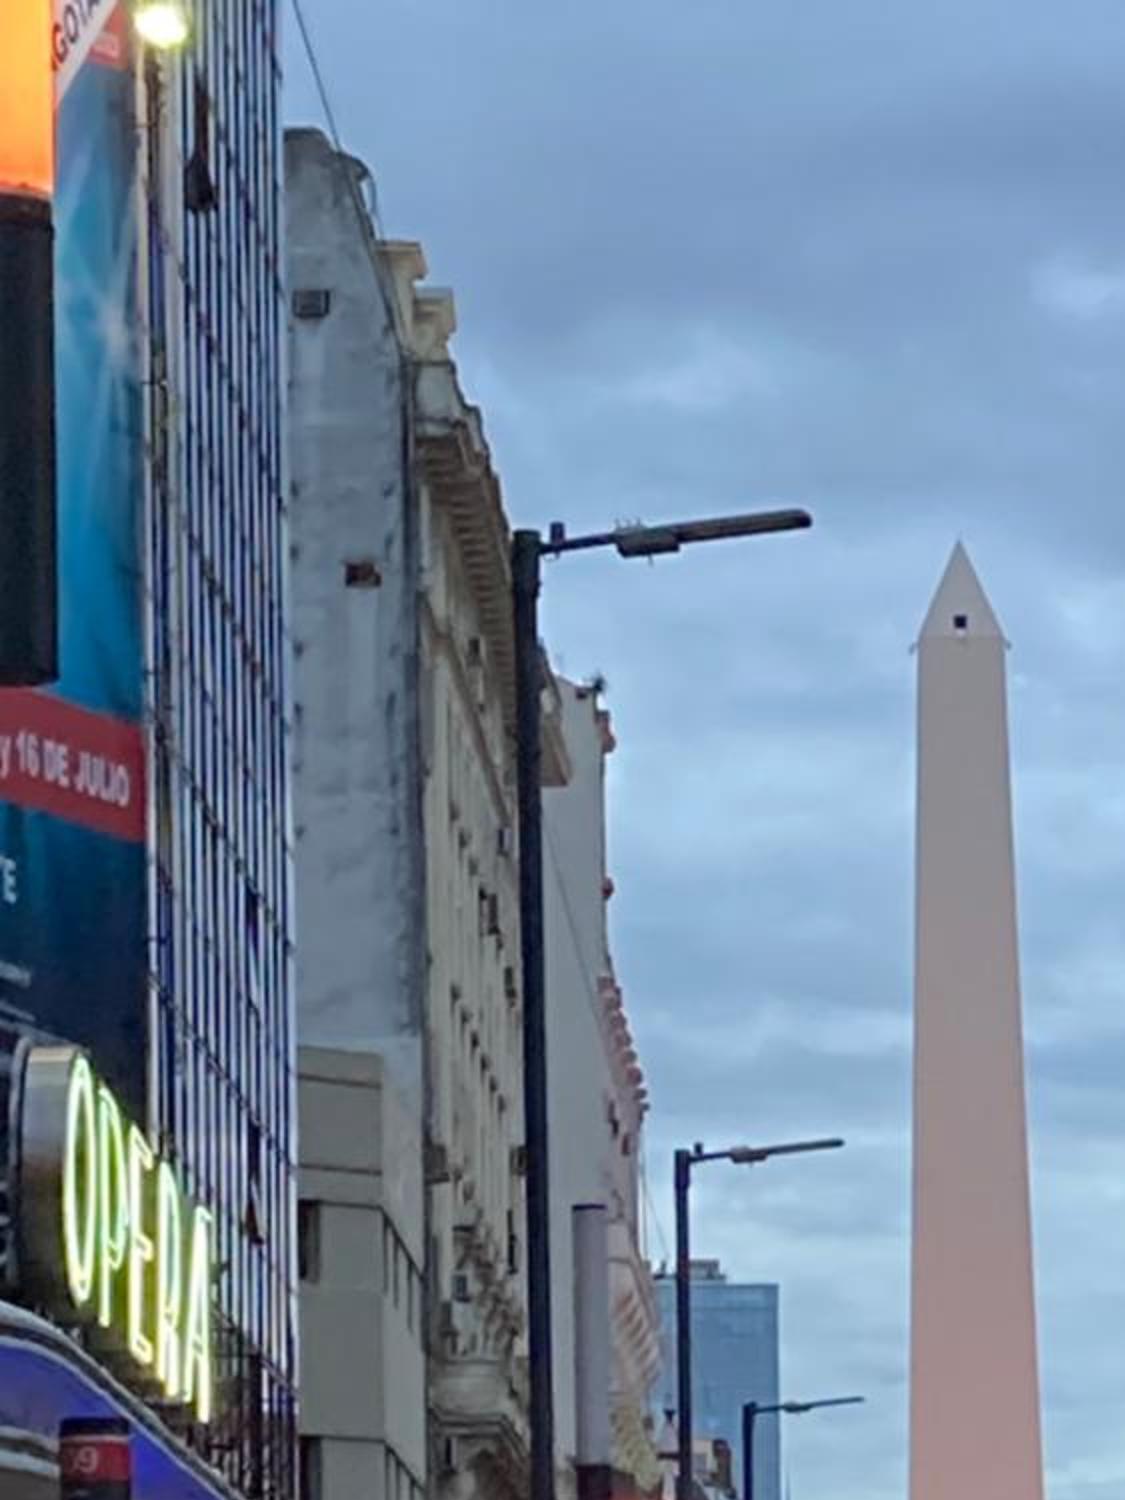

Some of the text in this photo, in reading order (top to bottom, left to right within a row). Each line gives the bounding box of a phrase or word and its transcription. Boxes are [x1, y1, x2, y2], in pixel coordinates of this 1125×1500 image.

[16, 731, 39, 777] 16
[44, 739, 69, 787] DE
[75, 751, 130, 807] JULIO
[64, 1054, 212, 1422] OPERA
